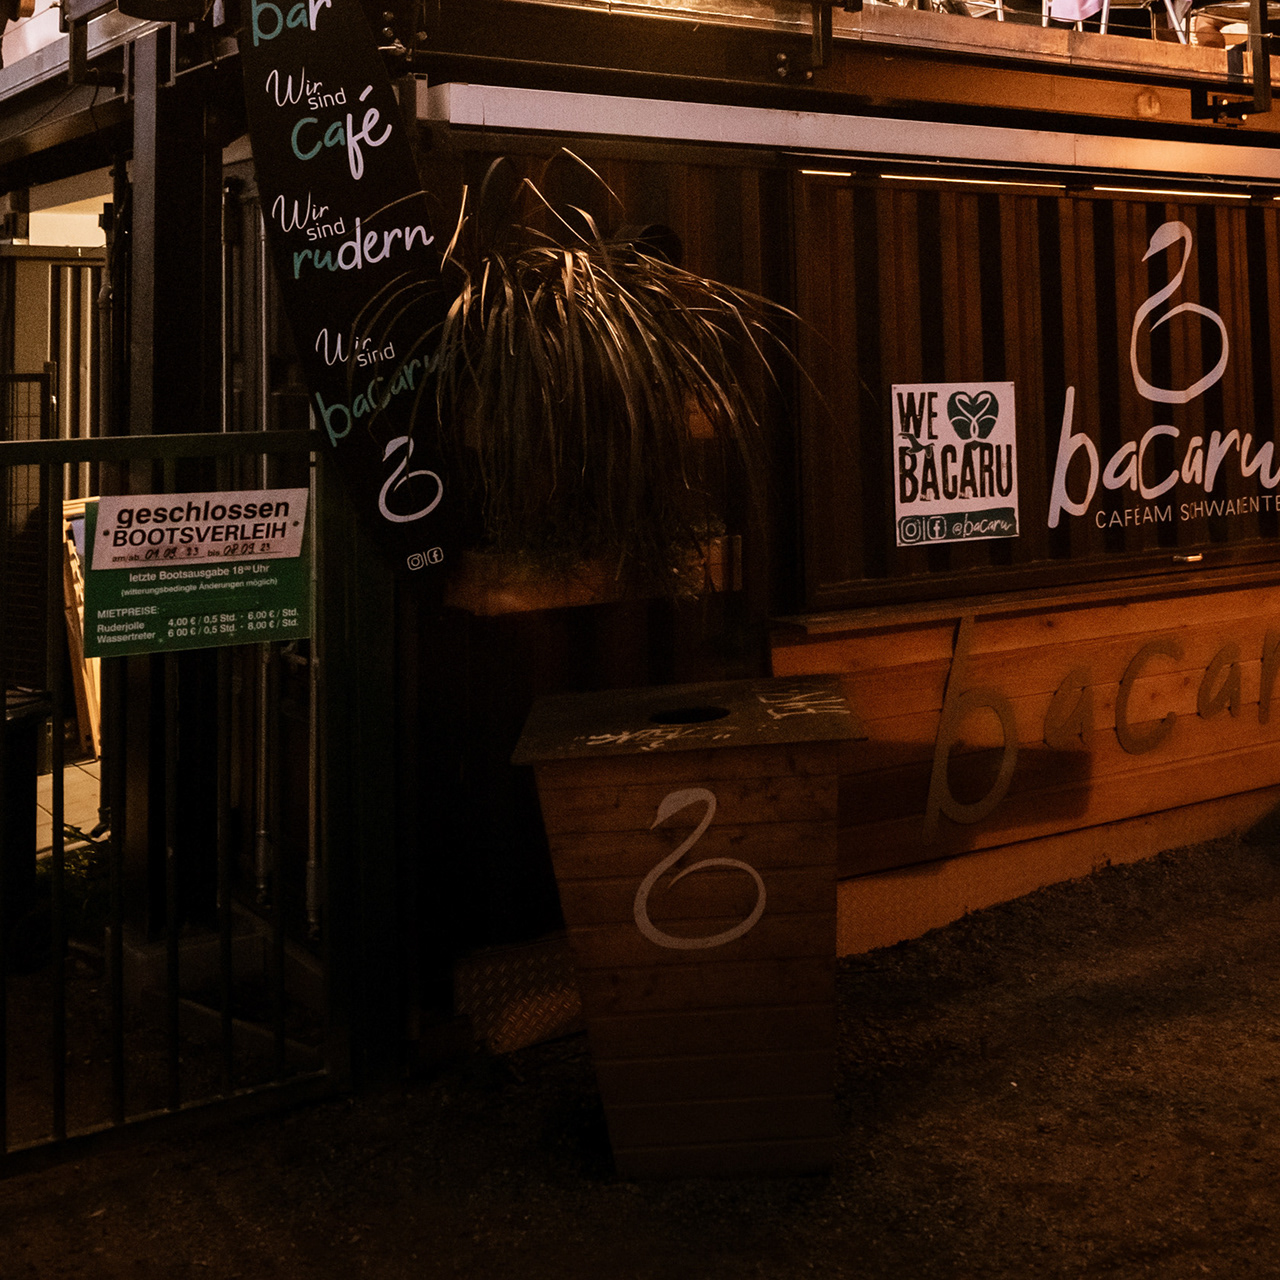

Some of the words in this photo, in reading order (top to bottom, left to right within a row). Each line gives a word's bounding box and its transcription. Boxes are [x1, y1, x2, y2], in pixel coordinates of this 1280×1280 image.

[266, 67, 323, 107] Wir
[307, 87, 347, 110] sind
[272, 190, 329, 233] Wir
[306, 217, 346, 241] sind
[292, 217, 435, 279] rudern
[356, 341, 396, 368] sind
[896, 391, 939, 440] WE
[898, 440, 1013, 504] BACARU
[116, 501, 290, 528] geschlossen
[112, 521, 287, 547] BOOTSVERLEIH
[207, 548, 220, 557] bis
[129, 573, 156, 583] letzte
[159, 567, 230, 580] Bootsausgabe
[252, 564, 270, 574] Uhr
[245, 577, 278, 589] möglich)
[97, 606, 160, 619] MIETPREISE:
[97, 621, 145, 634] Ruderjolle
[219, 613, 237, 623] Std.
[282, 608, 299, 617] Std.
[97, 631, 156, 643] Wassertreter
[219, 623, 237, 633] Std.
[282, 618, 299, 628] Std.
